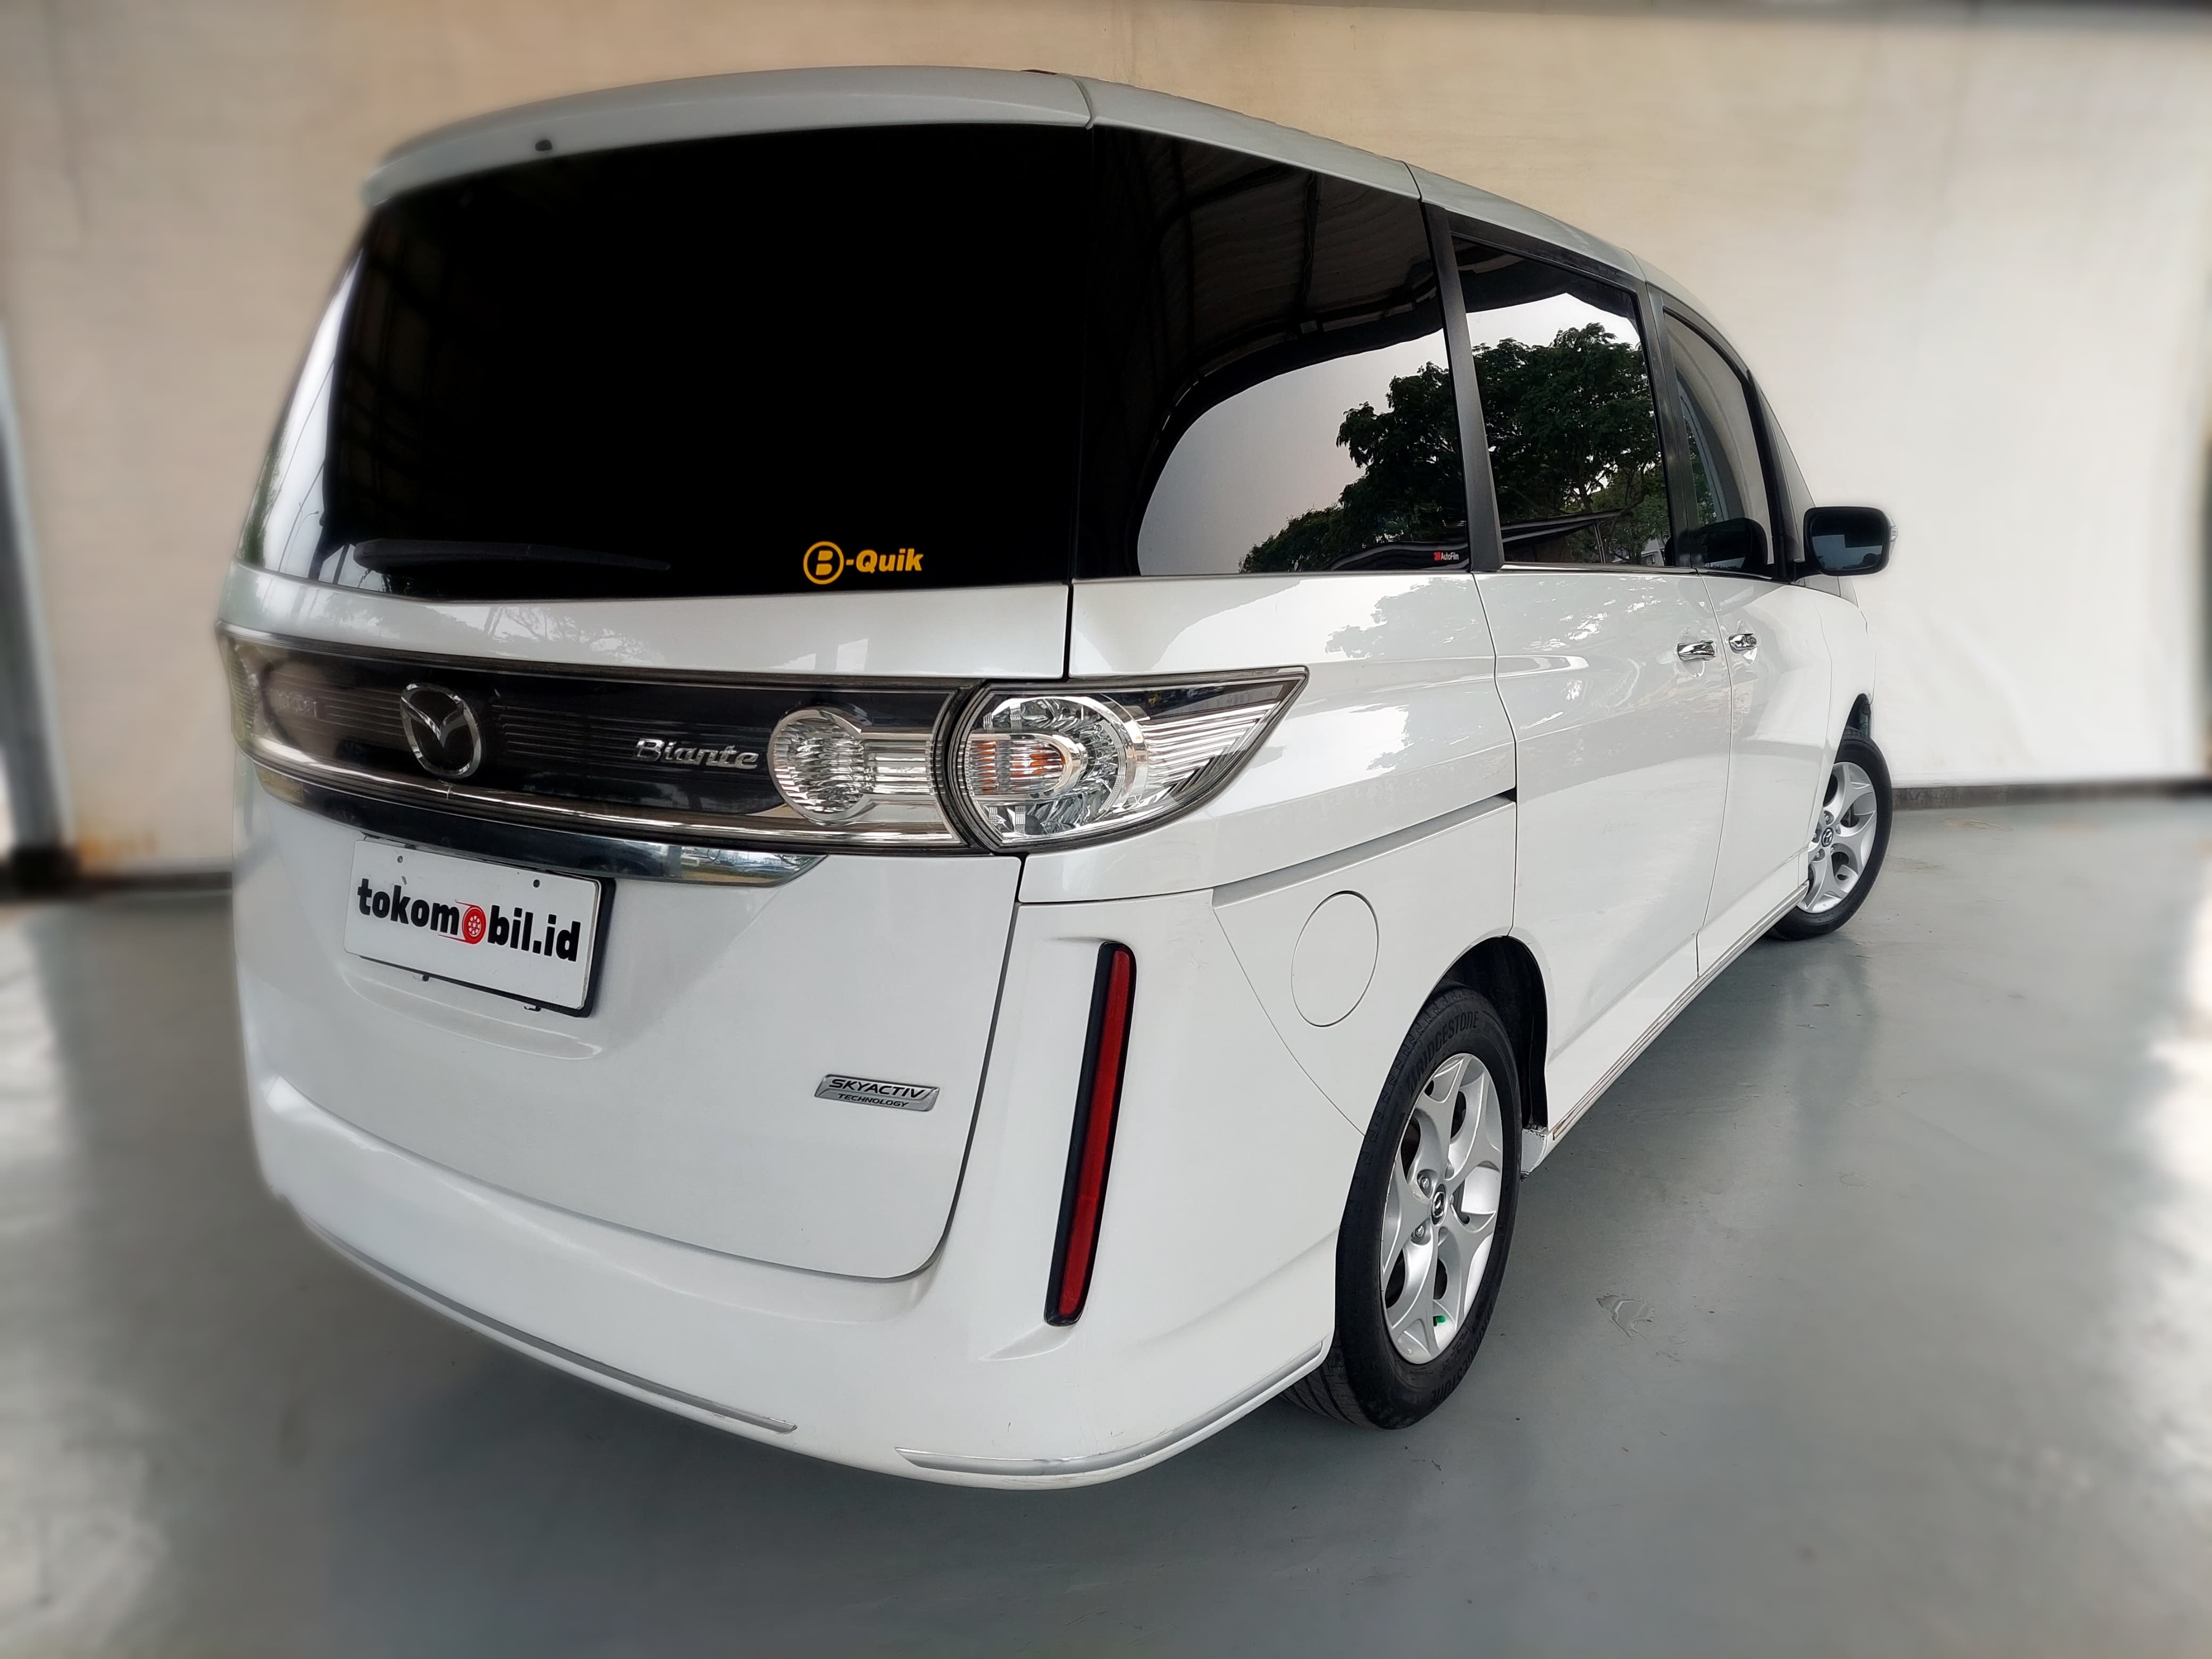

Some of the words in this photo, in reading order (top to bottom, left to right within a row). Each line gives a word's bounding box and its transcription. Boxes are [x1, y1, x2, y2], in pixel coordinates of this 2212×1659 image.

[803, 541, 924, 584] B-Quik
[634, 737, 759, 769] Biante
[828, 1078, 926, 1098] SKYACTIV
[837, 1093, 910, 1107] TECHNOLOGY
